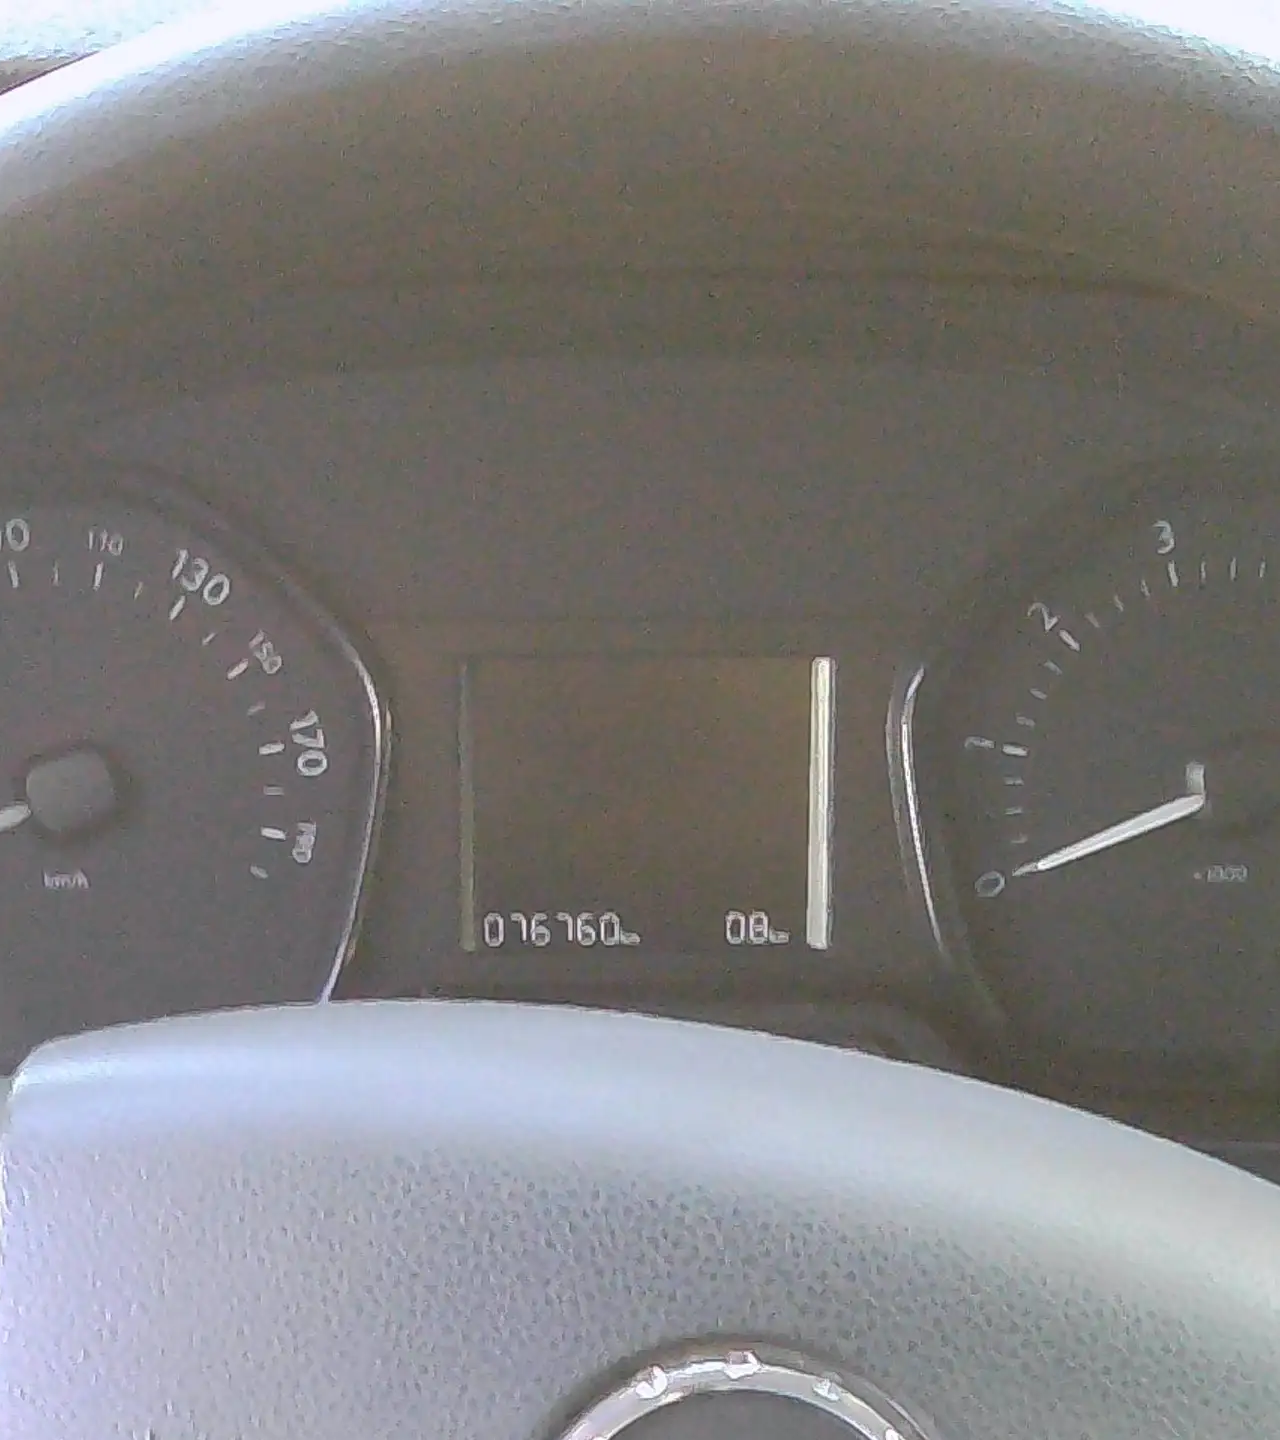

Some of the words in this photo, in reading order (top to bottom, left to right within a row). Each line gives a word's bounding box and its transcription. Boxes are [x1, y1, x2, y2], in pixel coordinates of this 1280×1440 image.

[87, 529, 124, 556] 110
[1152, 520, 1175, 554] 3
[171, 549, 231, 606] 130
[1027, 601, 1060, 632] 2
[289, 708, 328, 777] 170
[964, 735, 996, 749] 1
[975, 870, 1006, 898] 0
[483, 911, 620, 947] 076760
